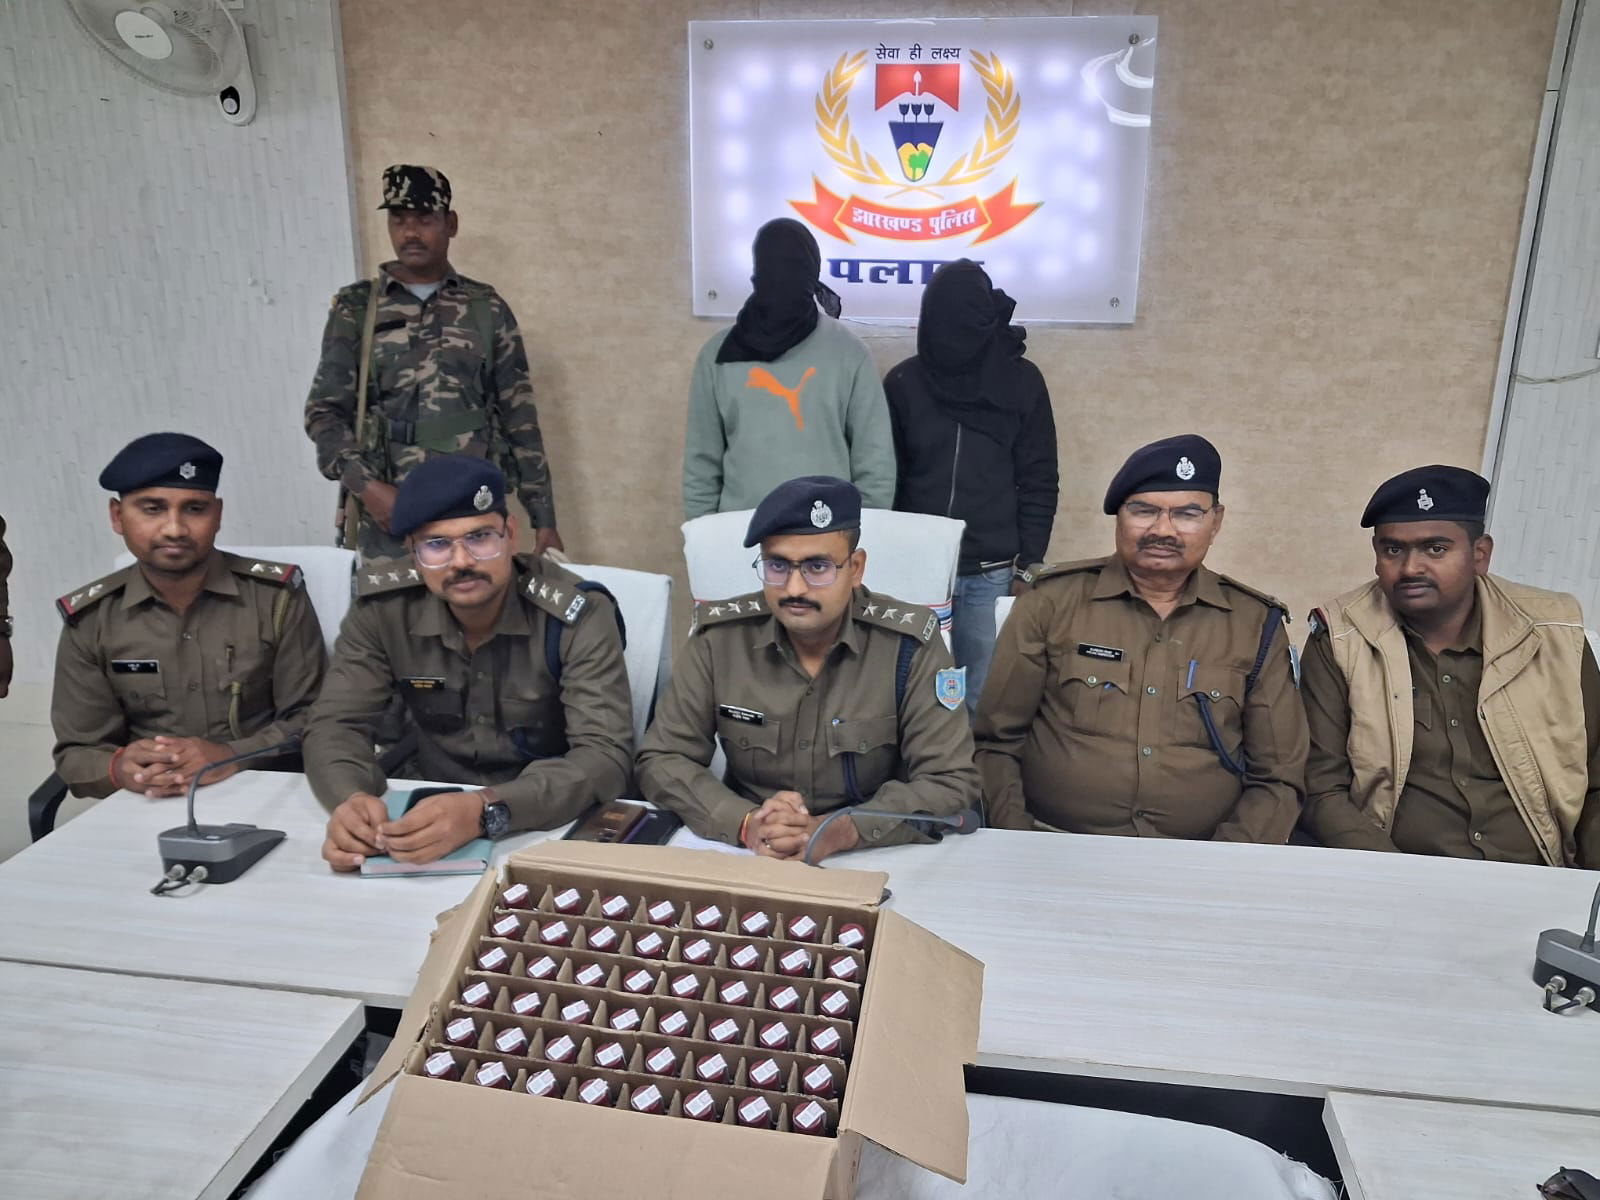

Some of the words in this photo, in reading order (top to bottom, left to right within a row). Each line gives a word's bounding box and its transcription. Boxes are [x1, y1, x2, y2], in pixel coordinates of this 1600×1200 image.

[875, 42, 900, 60] सेवा
[908, 42, 922, 60] ही
[931, 47, 961, 60] लक्ष्य
[852, 206, 924, 233] झारखण्ड
[928, 207, 977, 236] पुलिस
